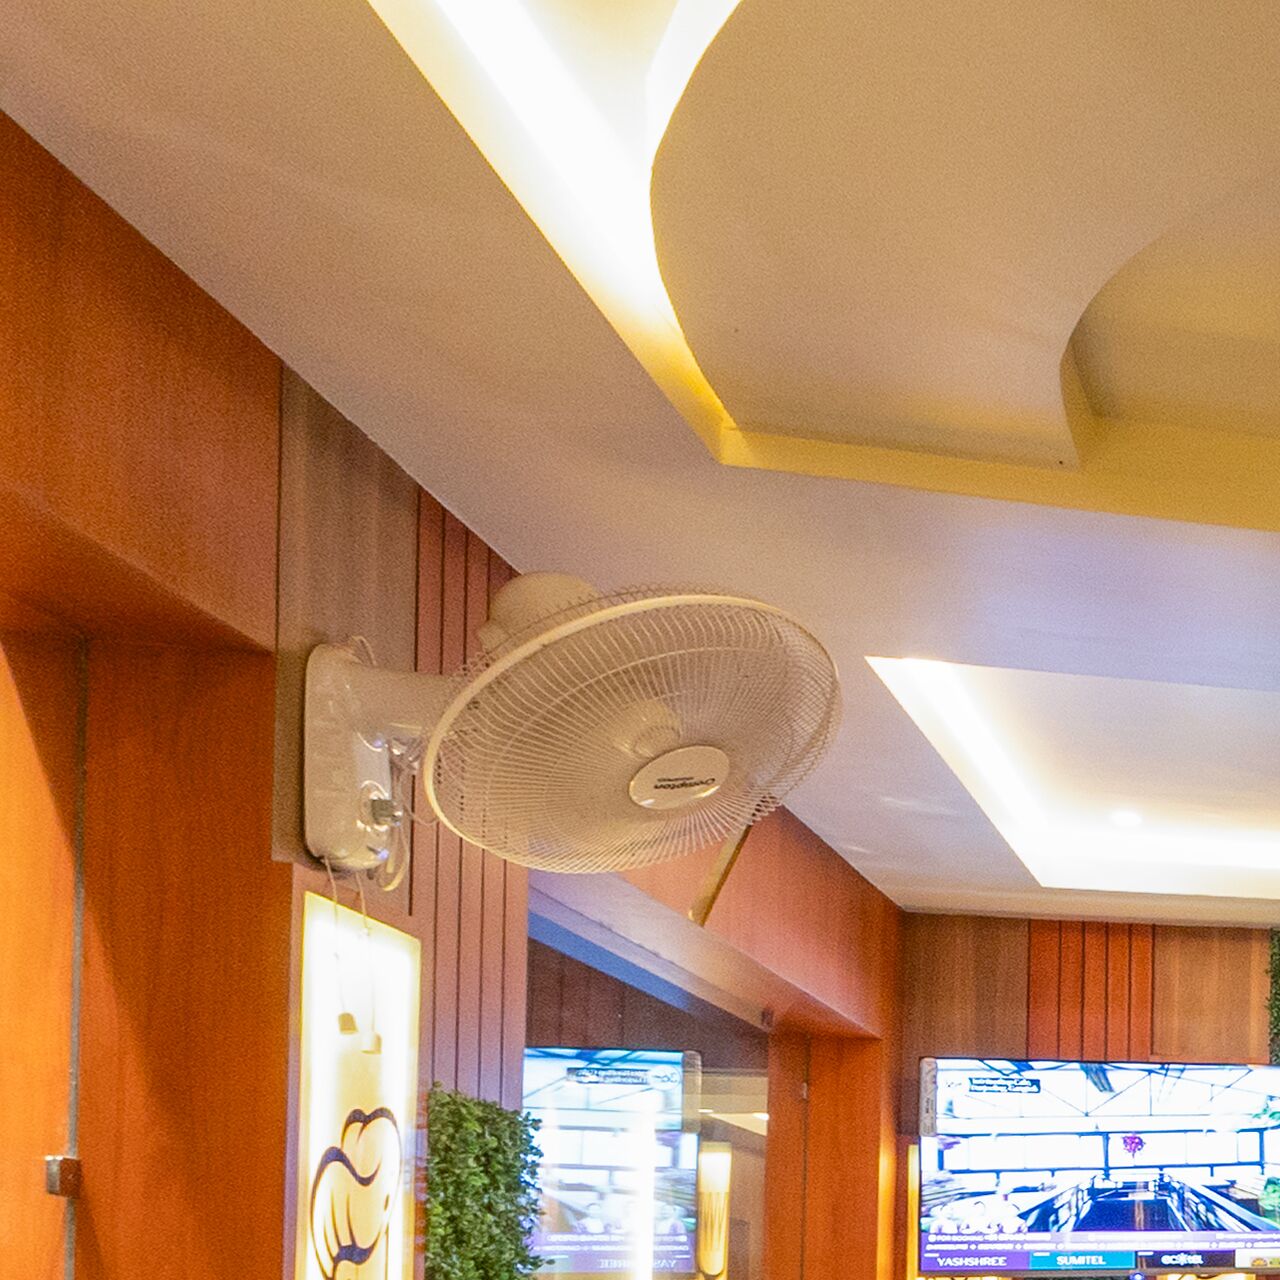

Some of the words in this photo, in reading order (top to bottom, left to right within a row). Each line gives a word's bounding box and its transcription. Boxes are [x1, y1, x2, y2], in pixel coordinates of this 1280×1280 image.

[653, 777, 716, 790] Crompton
[937, 1256, 1007, 1267] YASHSHREE
[1056, 1255, 1106, 1265] SUMITEL
